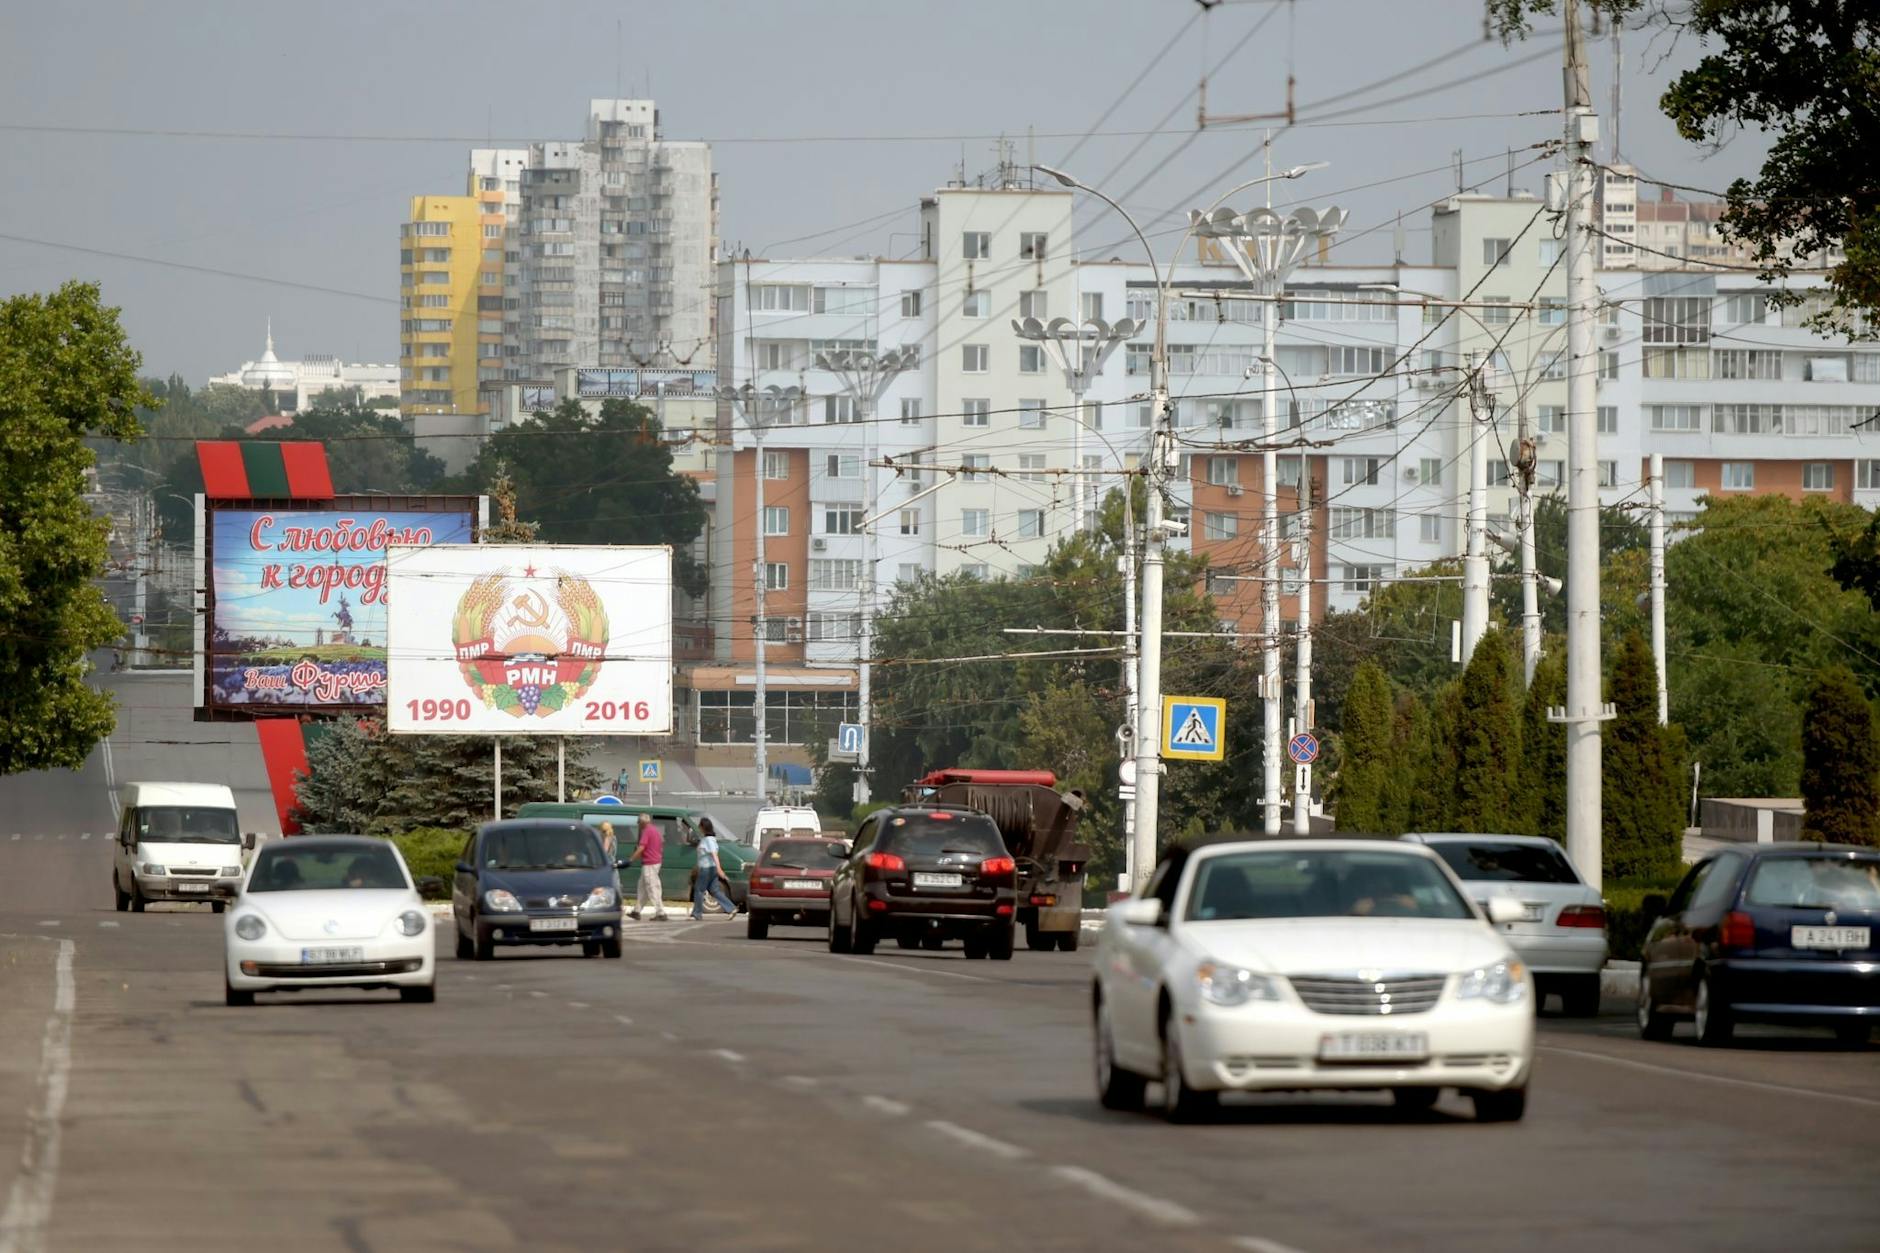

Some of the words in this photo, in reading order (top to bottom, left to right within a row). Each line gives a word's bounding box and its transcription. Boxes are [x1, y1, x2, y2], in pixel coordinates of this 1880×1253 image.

[250, 514, 274, 552] С
[279, 517, 433, 552] любовью
[261, 563, 284, 590] к
[289, 562, 389, 606] город
[459, 642, 490, 660] ПМР
[571, 641, 602, 660] ПМР
[244, 668, 288, 689] Ваш
[505, 666, 558, 687] РМН
[406, 698, 472, 721] 1990
[584, 700, 650, 721] 2016
